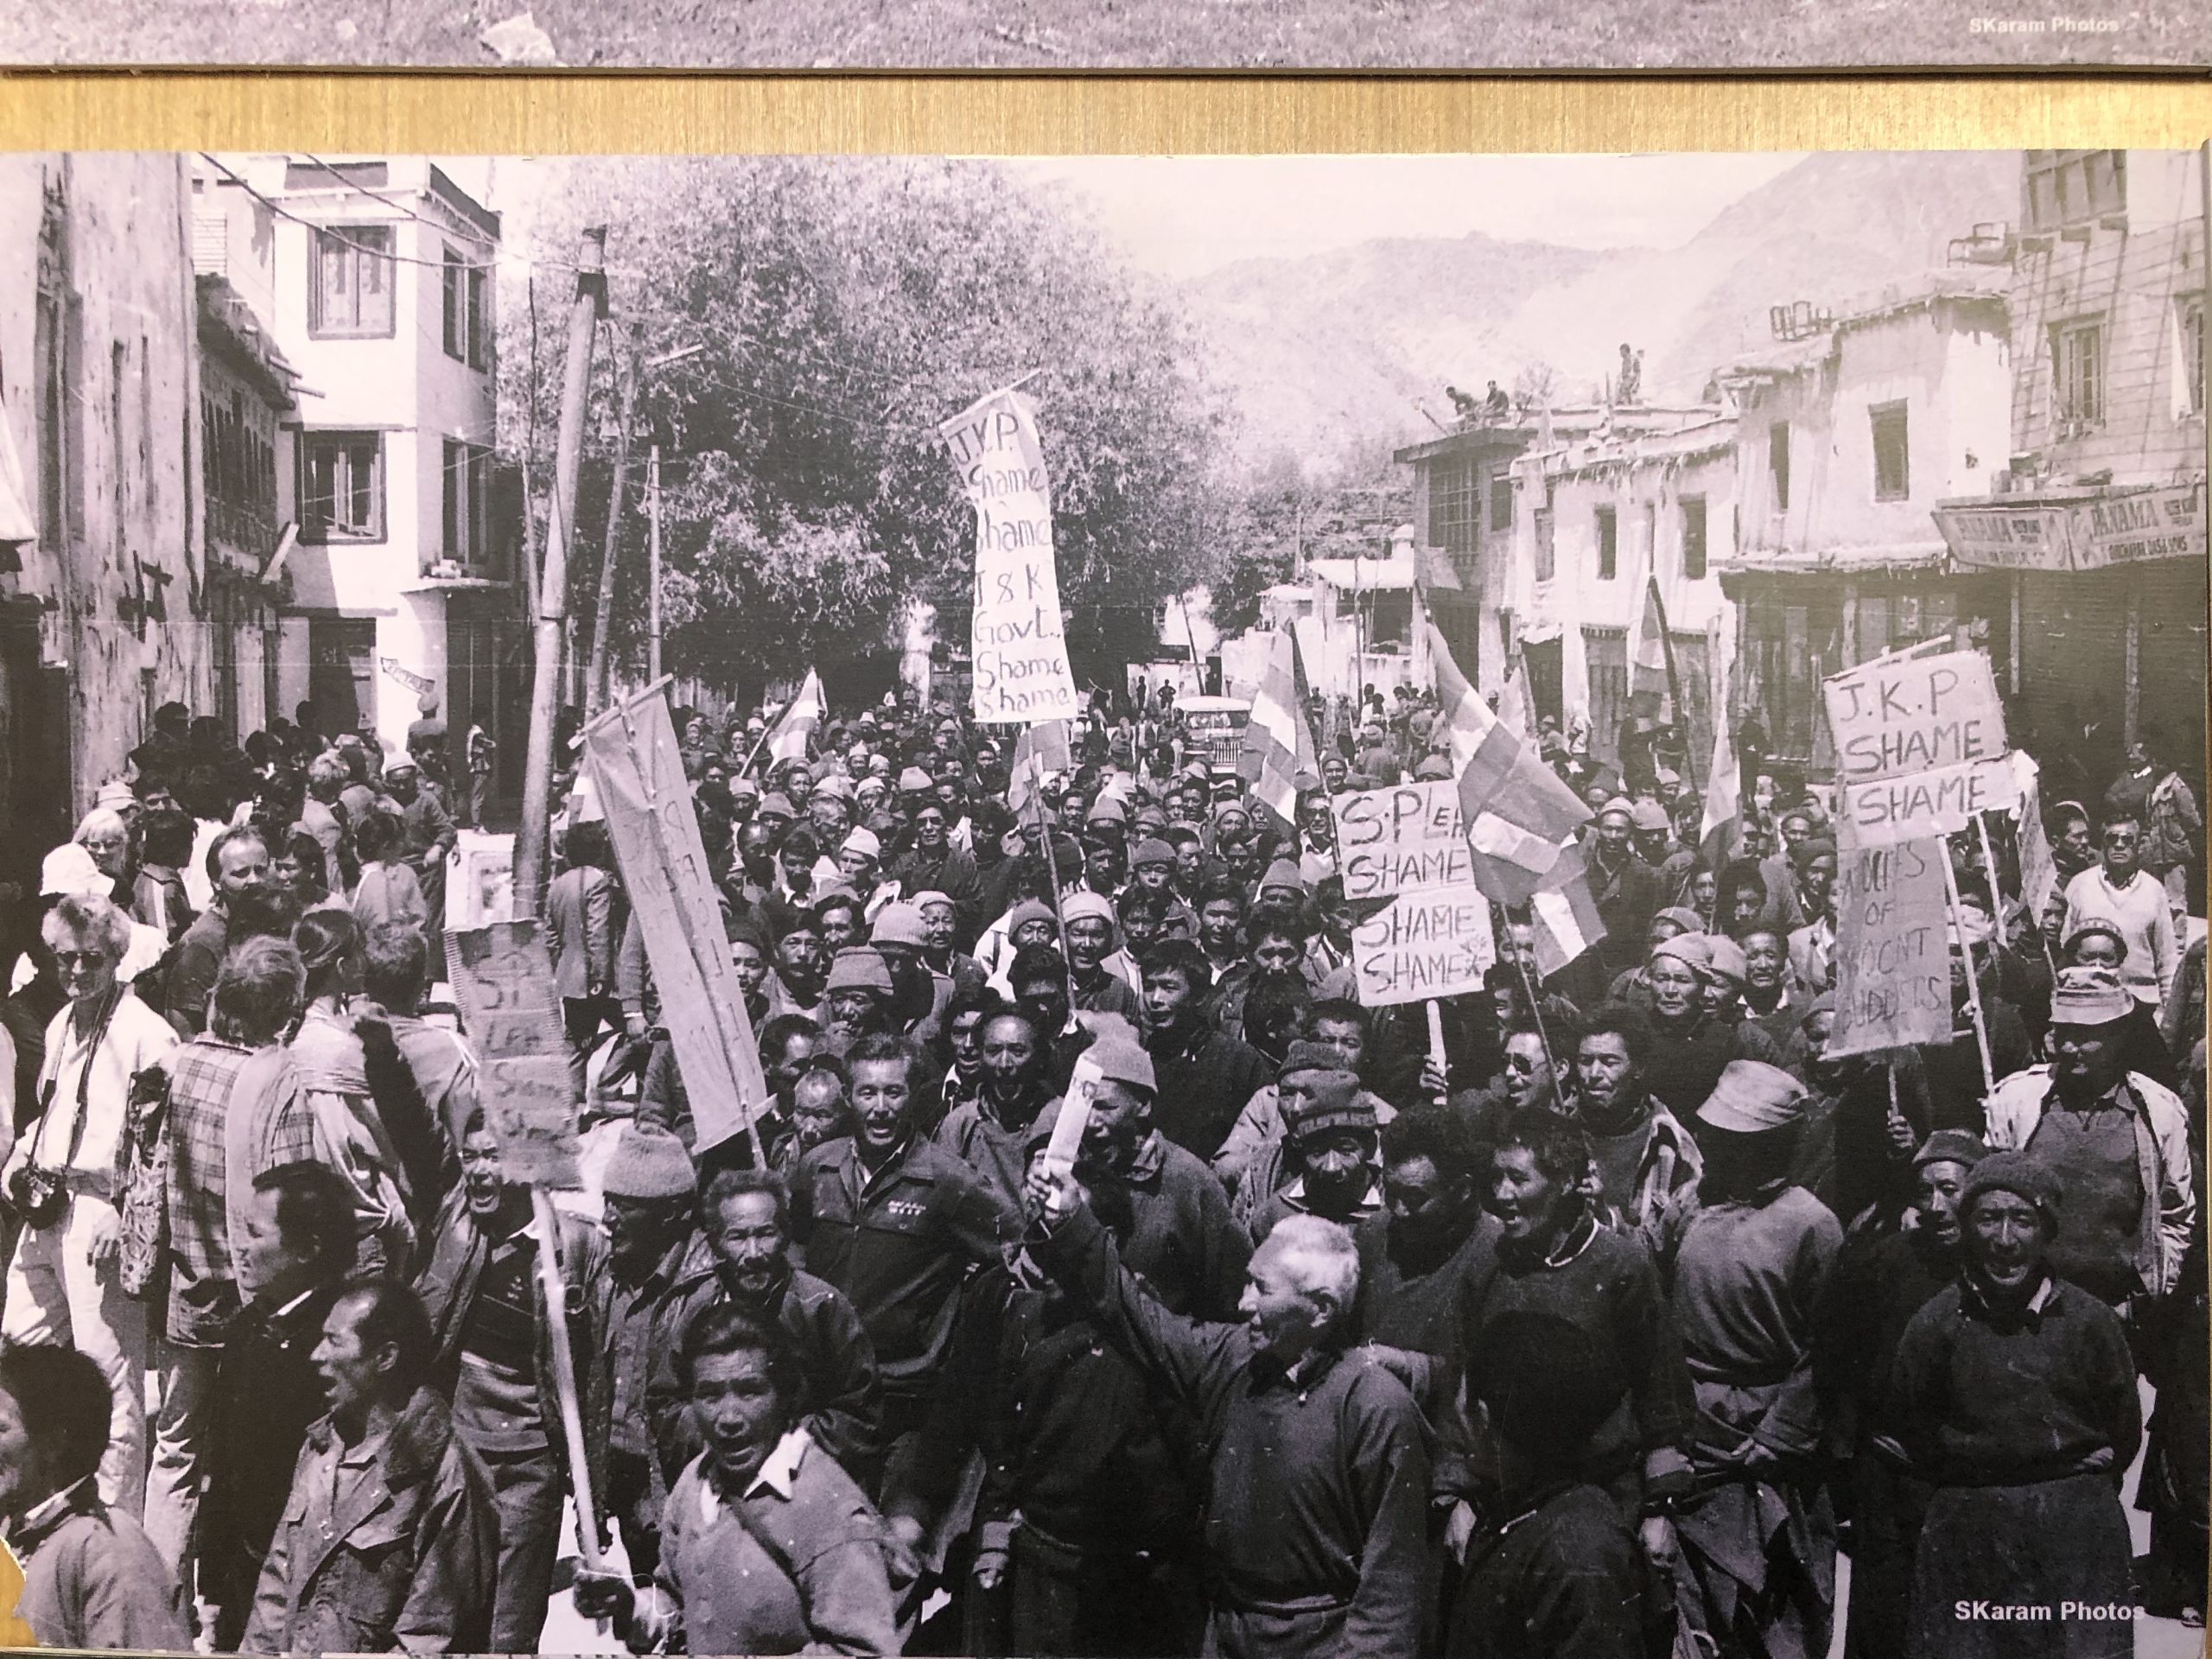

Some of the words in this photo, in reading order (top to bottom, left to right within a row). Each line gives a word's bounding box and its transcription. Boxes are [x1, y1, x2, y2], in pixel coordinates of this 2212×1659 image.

[1025, 563, 1044, 601] K
[976, 651, 1065, 691] Shame
[1839, 669, 1959, 722] J.K.P
[1846, 720, 1986, 773] SHAME
[1858, 775, 1986, 827] SHAME
[1347, 848, 1469, 894] SHAME
[1358, 904, 1475, 948] SHAME
